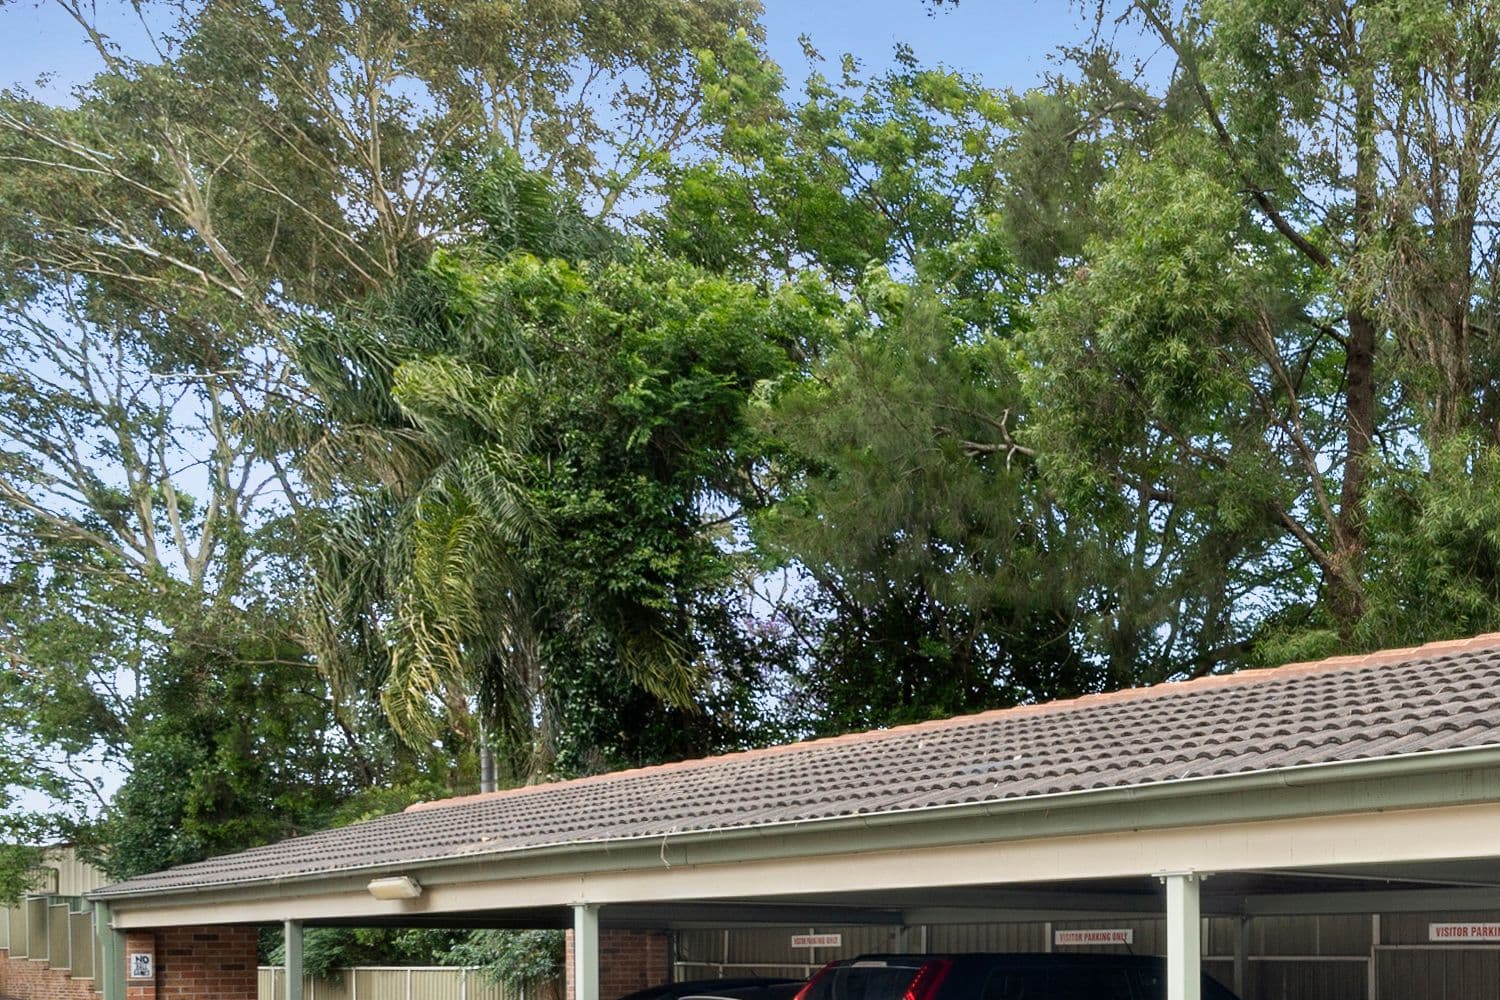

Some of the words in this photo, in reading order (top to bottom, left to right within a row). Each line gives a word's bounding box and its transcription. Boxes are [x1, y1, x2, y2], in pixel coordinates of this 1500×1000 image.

[1084, 932, 1111, 942] PARKING
[1436, 927, 1468, 937] VISITOR
[135, 955, 149, 964] NO
